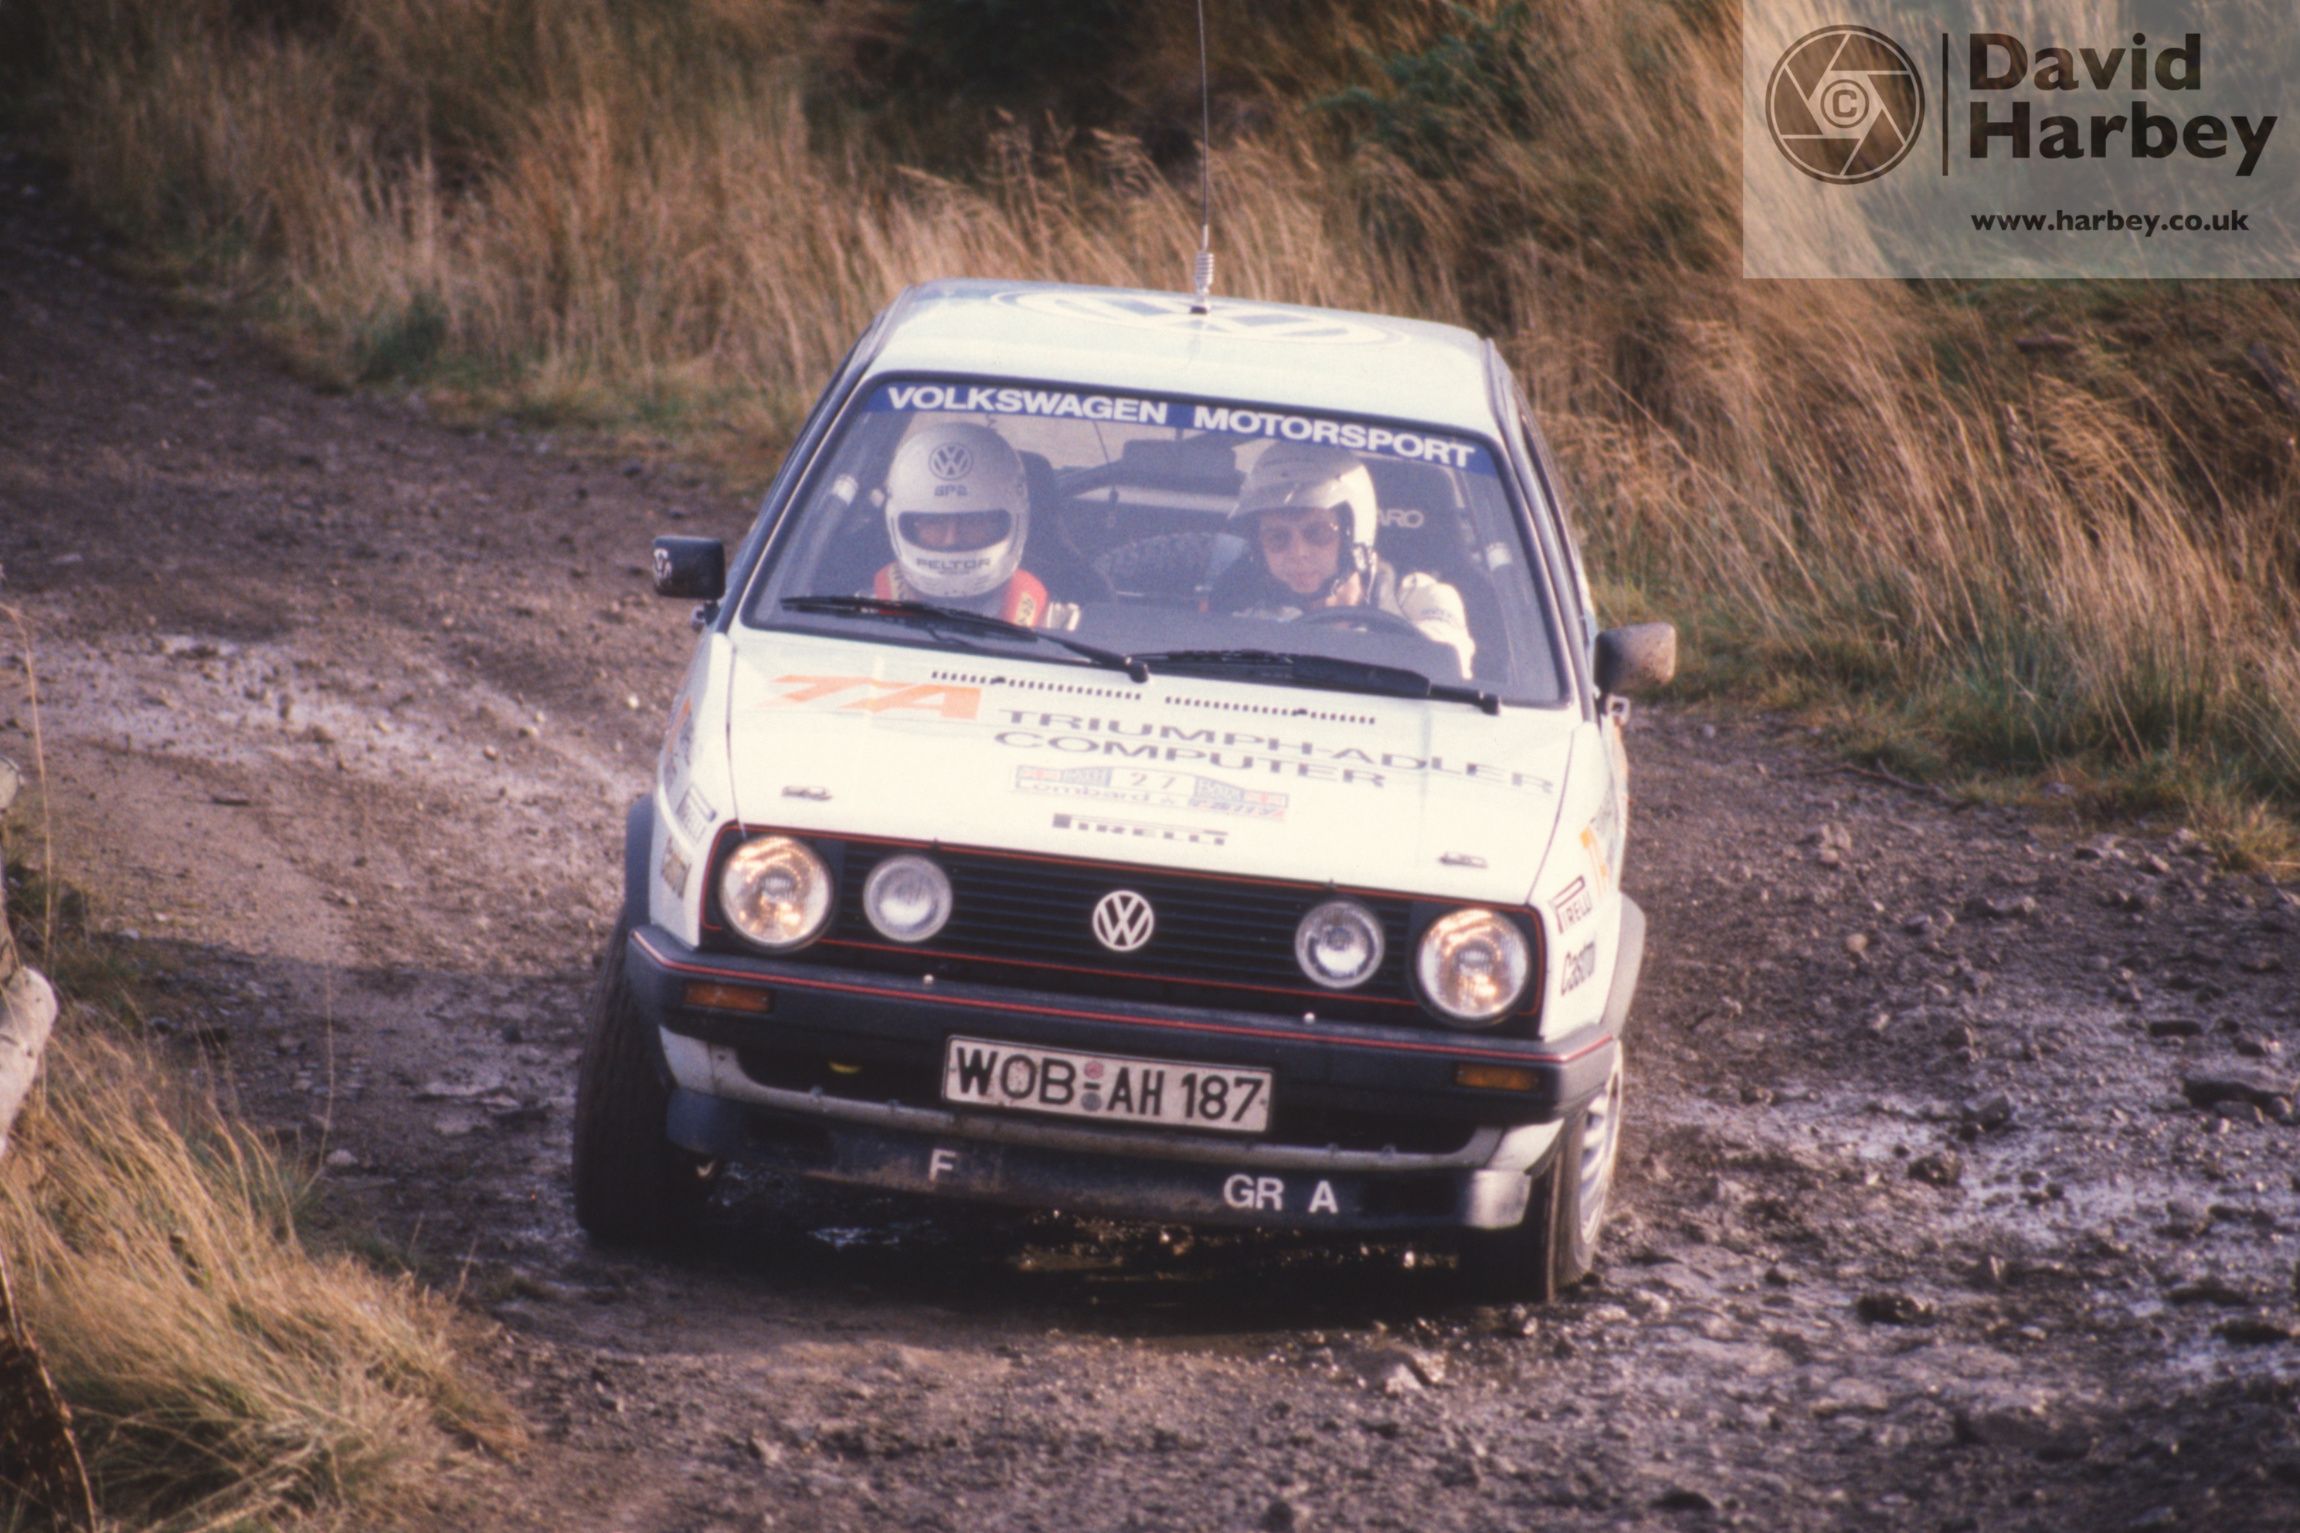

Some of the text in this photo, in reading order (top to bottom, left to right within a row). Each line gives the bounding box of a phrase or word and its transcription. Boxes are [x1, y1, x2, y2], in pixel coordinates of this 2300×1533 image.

[887, 386, 1476, 468] VOLKSWAGEN MOTORSPORT
[994, 731, 1387, 789] COMPUTER
[1180, 1072, 1265, 1122] 187
[929, 1148, 958, 1181] F
[1223, 1173, 1340, 1214] GR A
